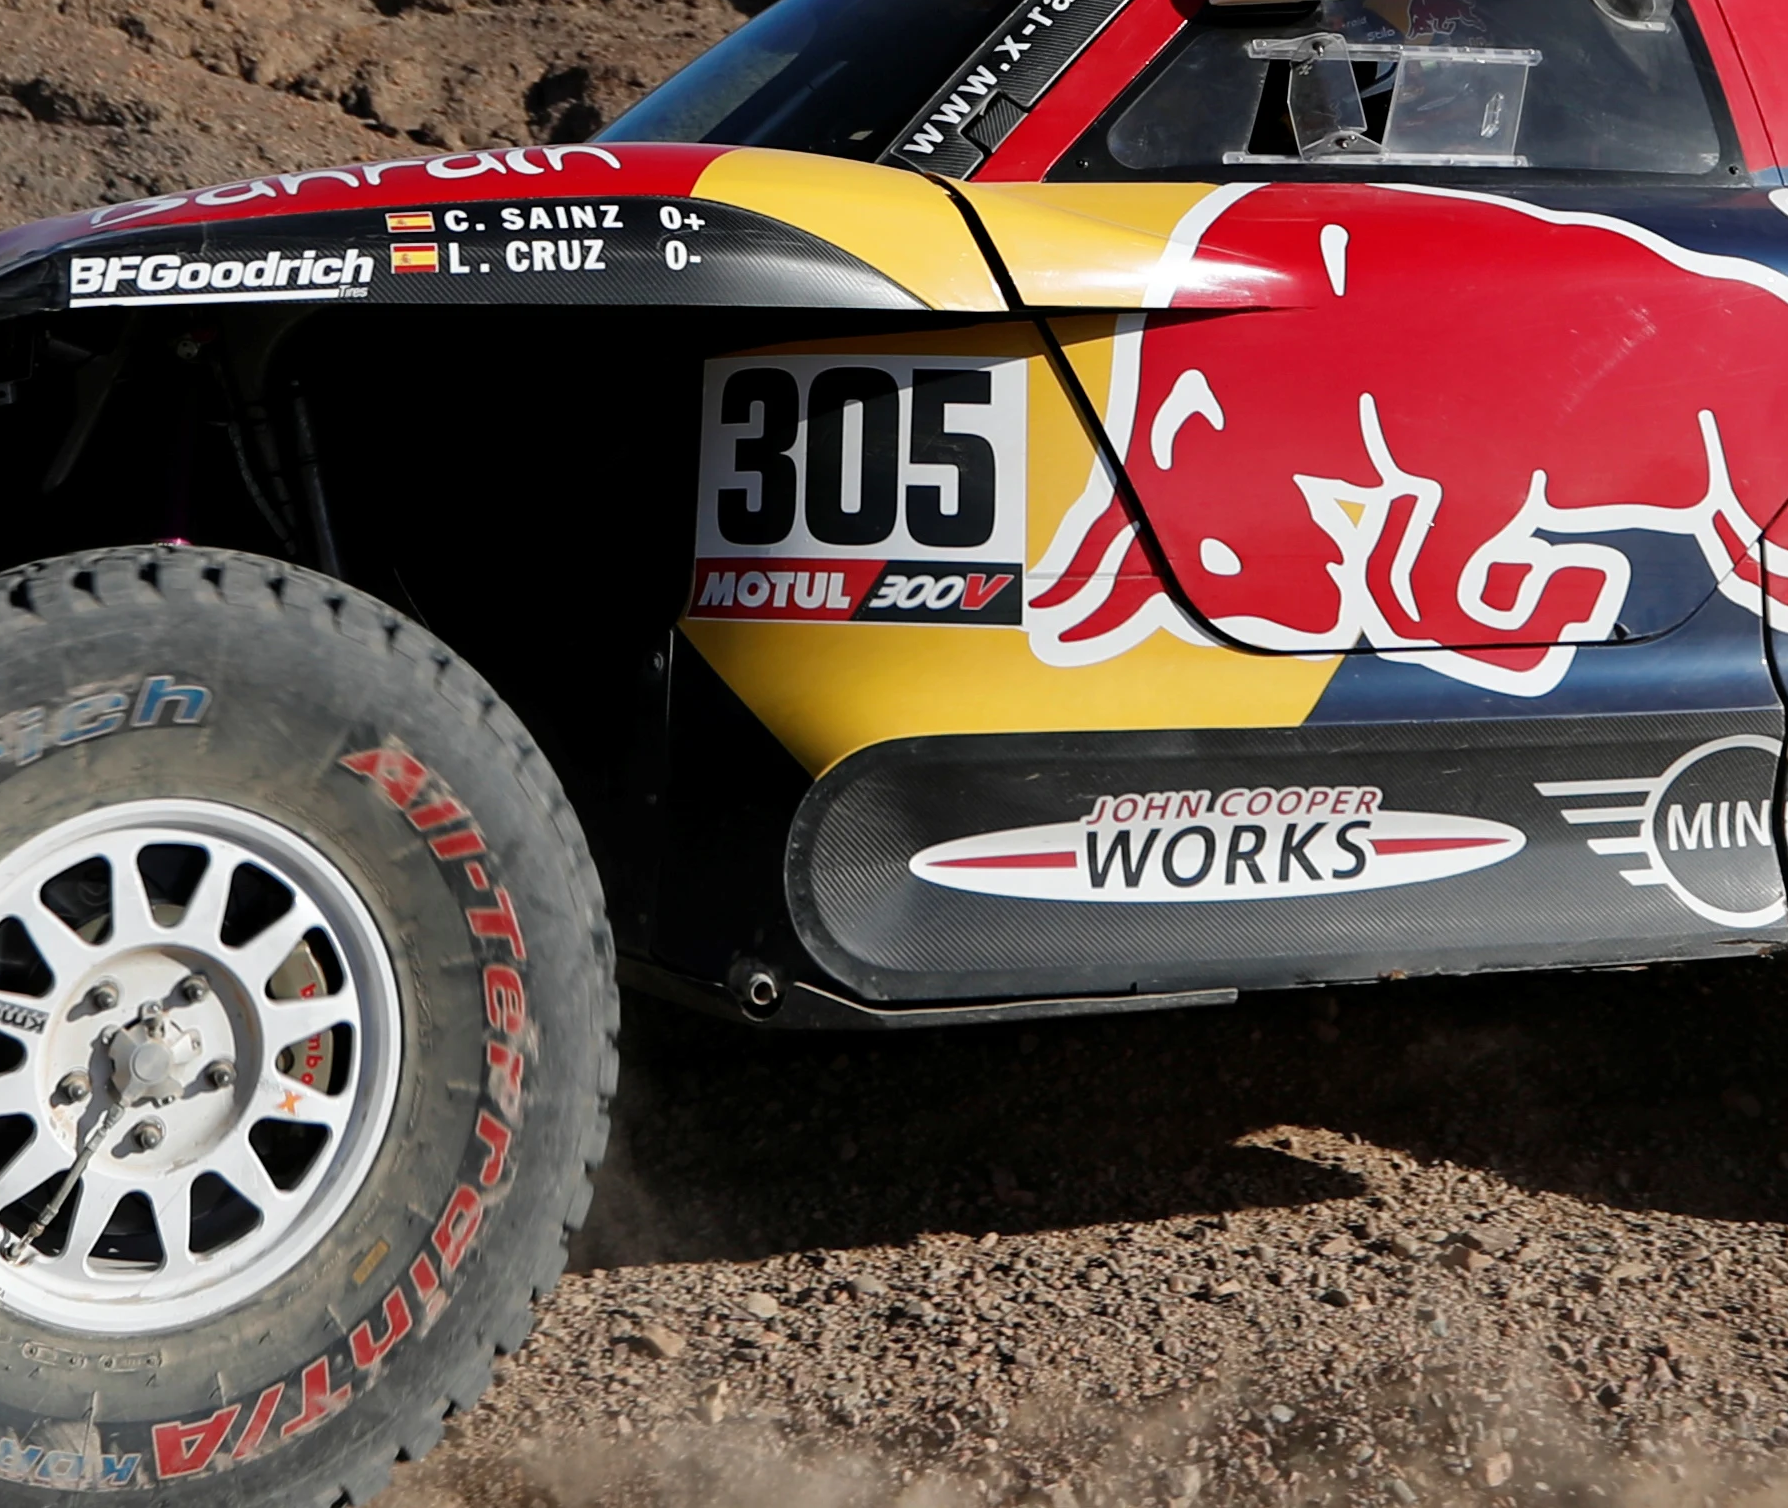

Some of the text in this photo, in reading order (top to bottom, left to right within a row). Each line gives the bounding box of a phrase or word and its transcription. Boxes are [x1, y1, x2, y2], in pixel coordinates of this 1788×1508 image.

[443, 209, 486, 232] C.
[500, 205, 625, 231] SAINZ
[70, 248, 375, 295] BFGoodrich
[448, 242, 491, 275] L.
[505, 239, 607, 272] CRUZ
[338, 284, 369, 299] Tires
[717, 366, 996, 548] 305
[697, 571, 1015, 611] MOTUL 300V
[1086, 791, 1379, 825] JOHN COOPER
[1086, 820, 1373, 889] WORKS
